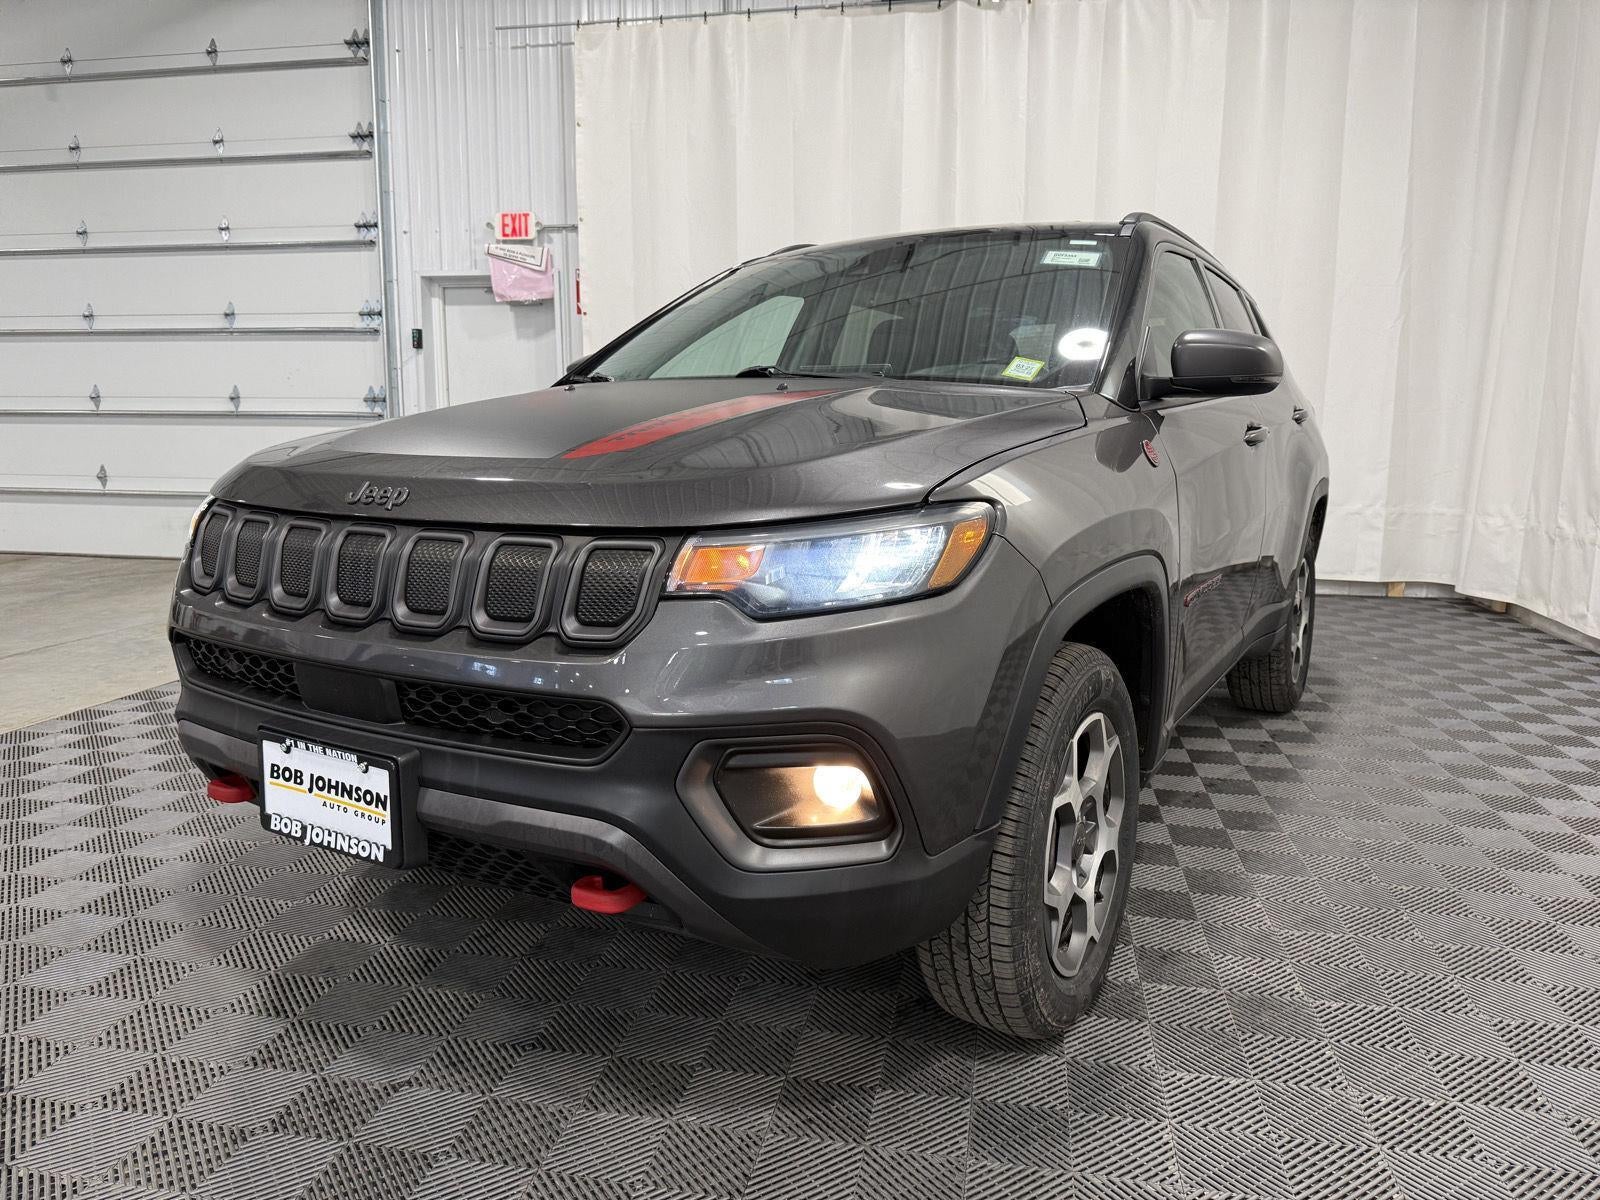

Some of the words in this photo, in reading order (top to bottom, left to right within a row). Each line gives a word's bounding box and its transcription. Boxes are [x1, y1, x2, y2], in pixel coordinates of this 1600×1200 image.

[501, 213, 530, 238] EXIT
[345, 481, 410, 511] Jeep
[285, 738, 295, 748] #1
[296, 740, 306, 750] IN
[307, 743, 325, 755] THE
[325, 747, 358, 763] NATION
[270, 763, 304, 786] BOB
[308, 773, 388, 811] JOHNSON
[322, 801, 348, 814] AUTO
[353, 810, 386, 826] GROUP
[270, 813, 302, 838] BOB
[304, 824, 385, 863] JOHNSON
